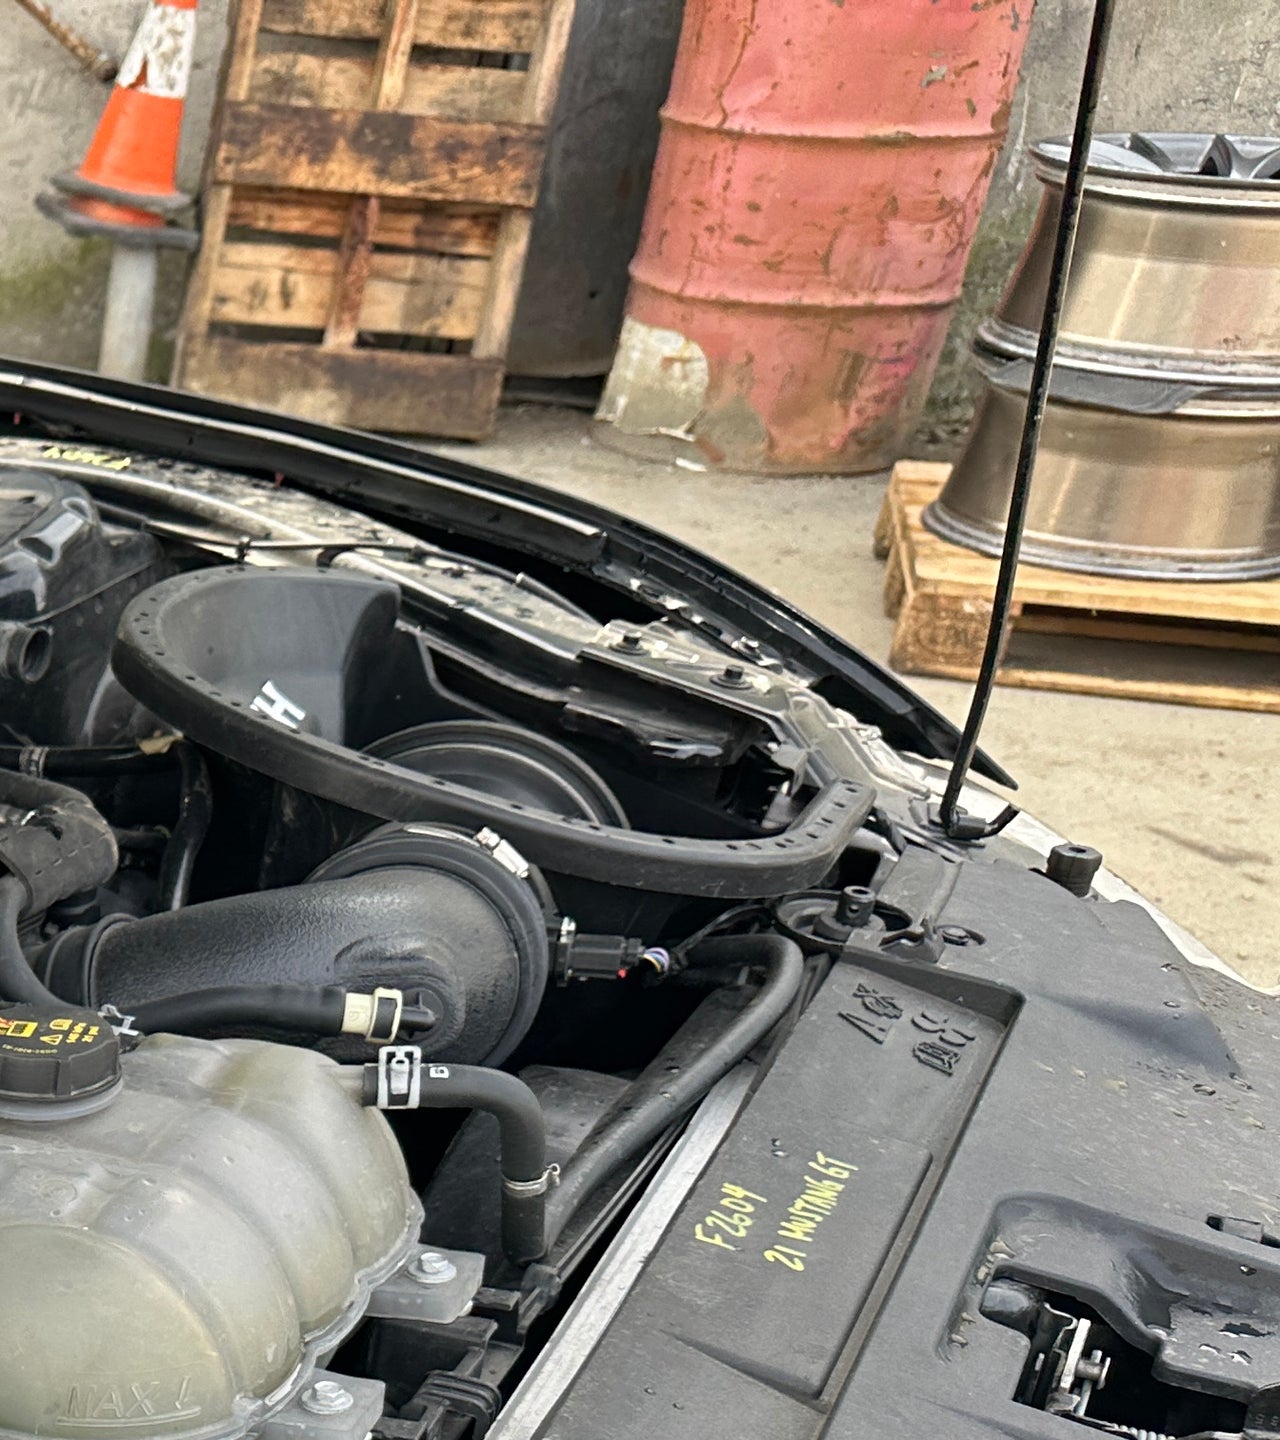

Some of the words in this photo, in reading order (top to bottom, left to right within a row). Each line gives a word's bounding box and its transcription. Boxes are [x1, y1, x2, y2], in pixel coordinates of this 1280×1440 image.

[694, 1181, 768, 1251] F2604
[777, 1174, 846, 1242] MUSTANG
[763, 1244, 807, 1272] 21
[64, 1381, 161, 1418] MAX
